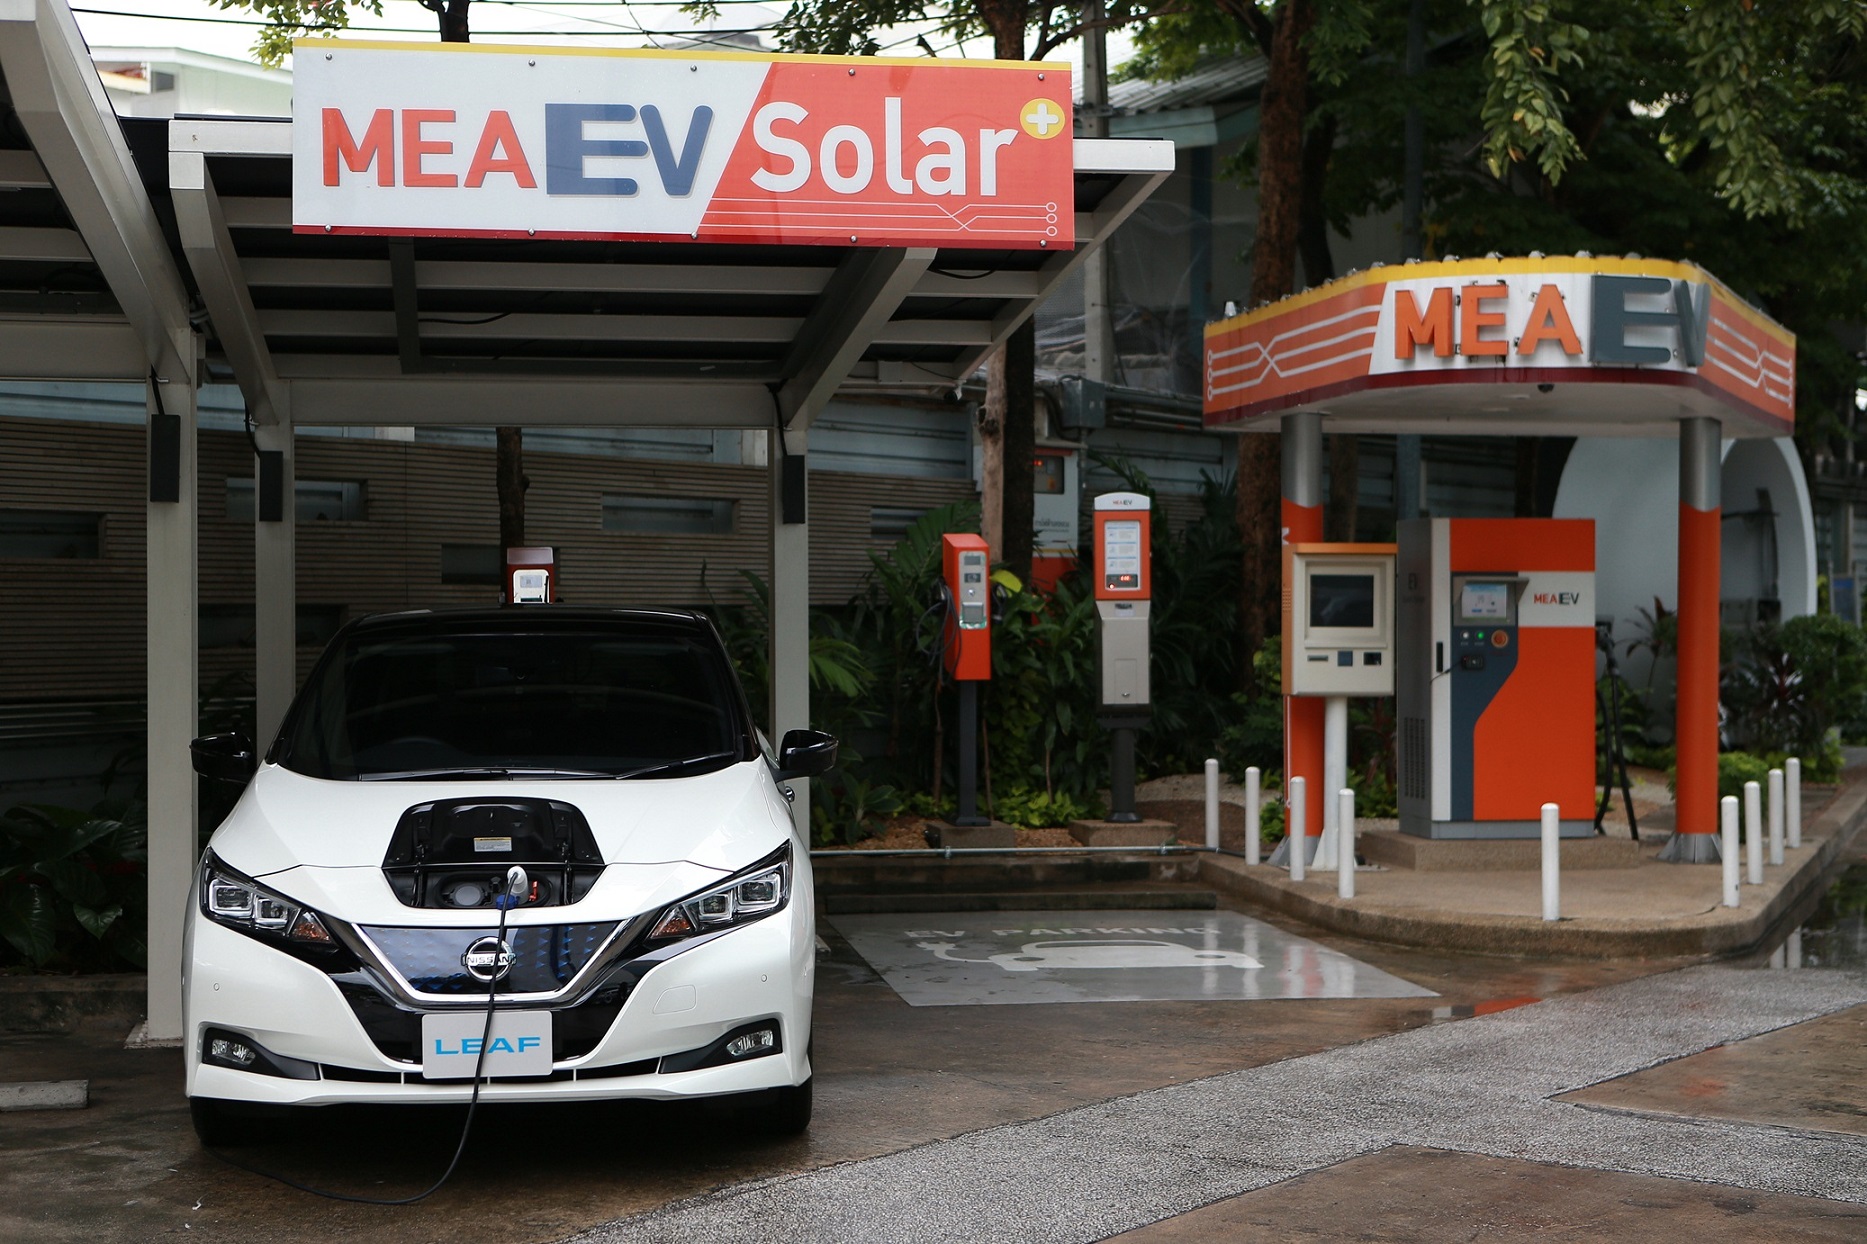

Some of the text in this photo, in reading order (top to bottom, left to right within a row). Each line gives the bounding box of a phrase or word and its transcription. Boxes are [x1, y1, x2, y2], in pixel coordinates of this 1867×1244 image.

[904, 927, 1222, 938] EV PARKING
[435, 1037, 541, 1054] LEAF
